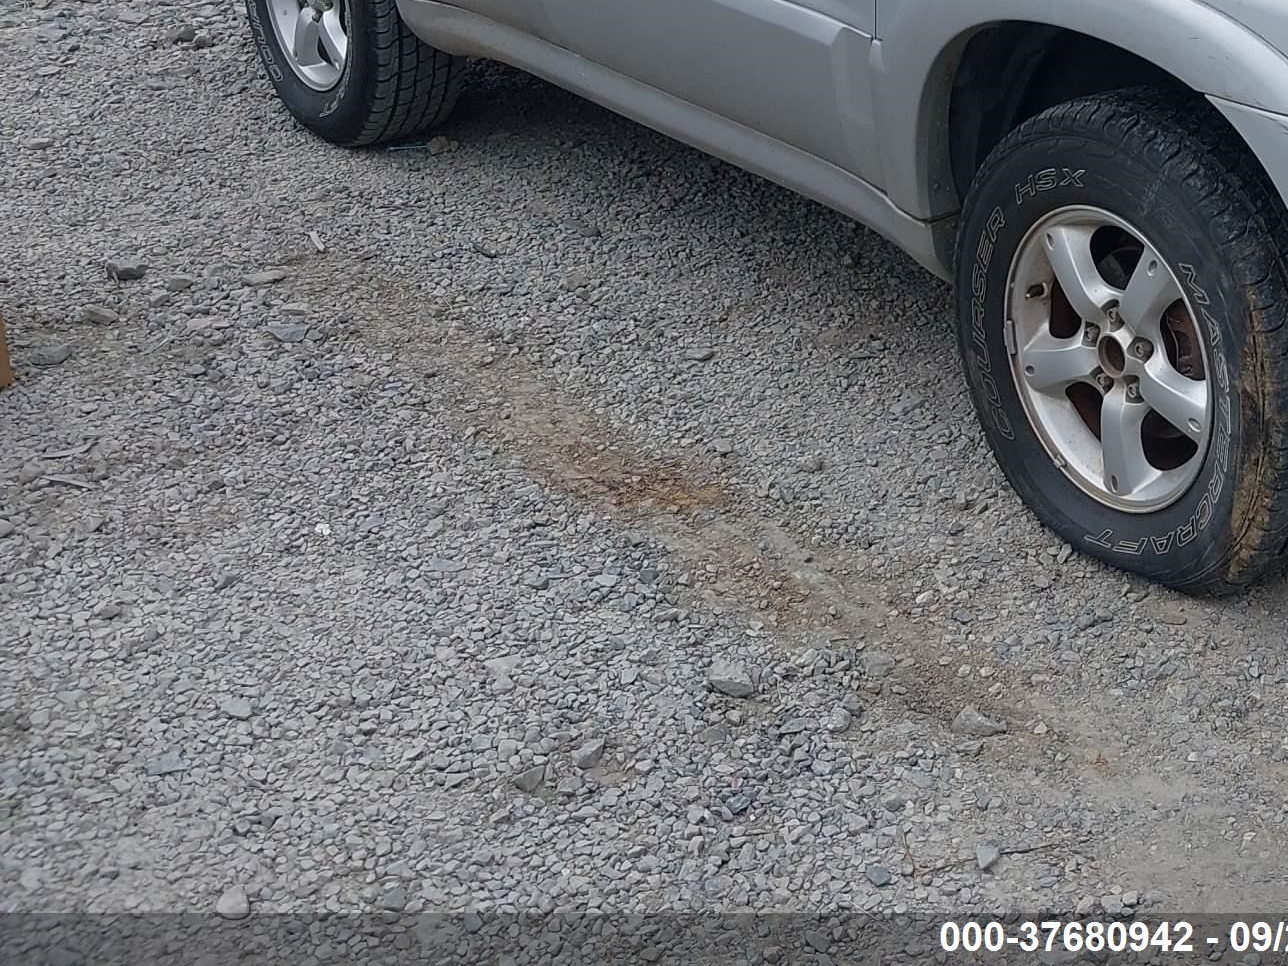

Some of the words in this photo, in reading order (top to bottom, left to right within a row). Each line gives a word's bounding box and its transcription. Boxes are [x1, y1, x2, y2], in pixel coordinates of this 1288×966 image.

[971, 206, 1014, 440] COURSER
[1014, 168, 1086, 205] HSX
[1083, 263, 1232, 555] MASTERCRAFT
